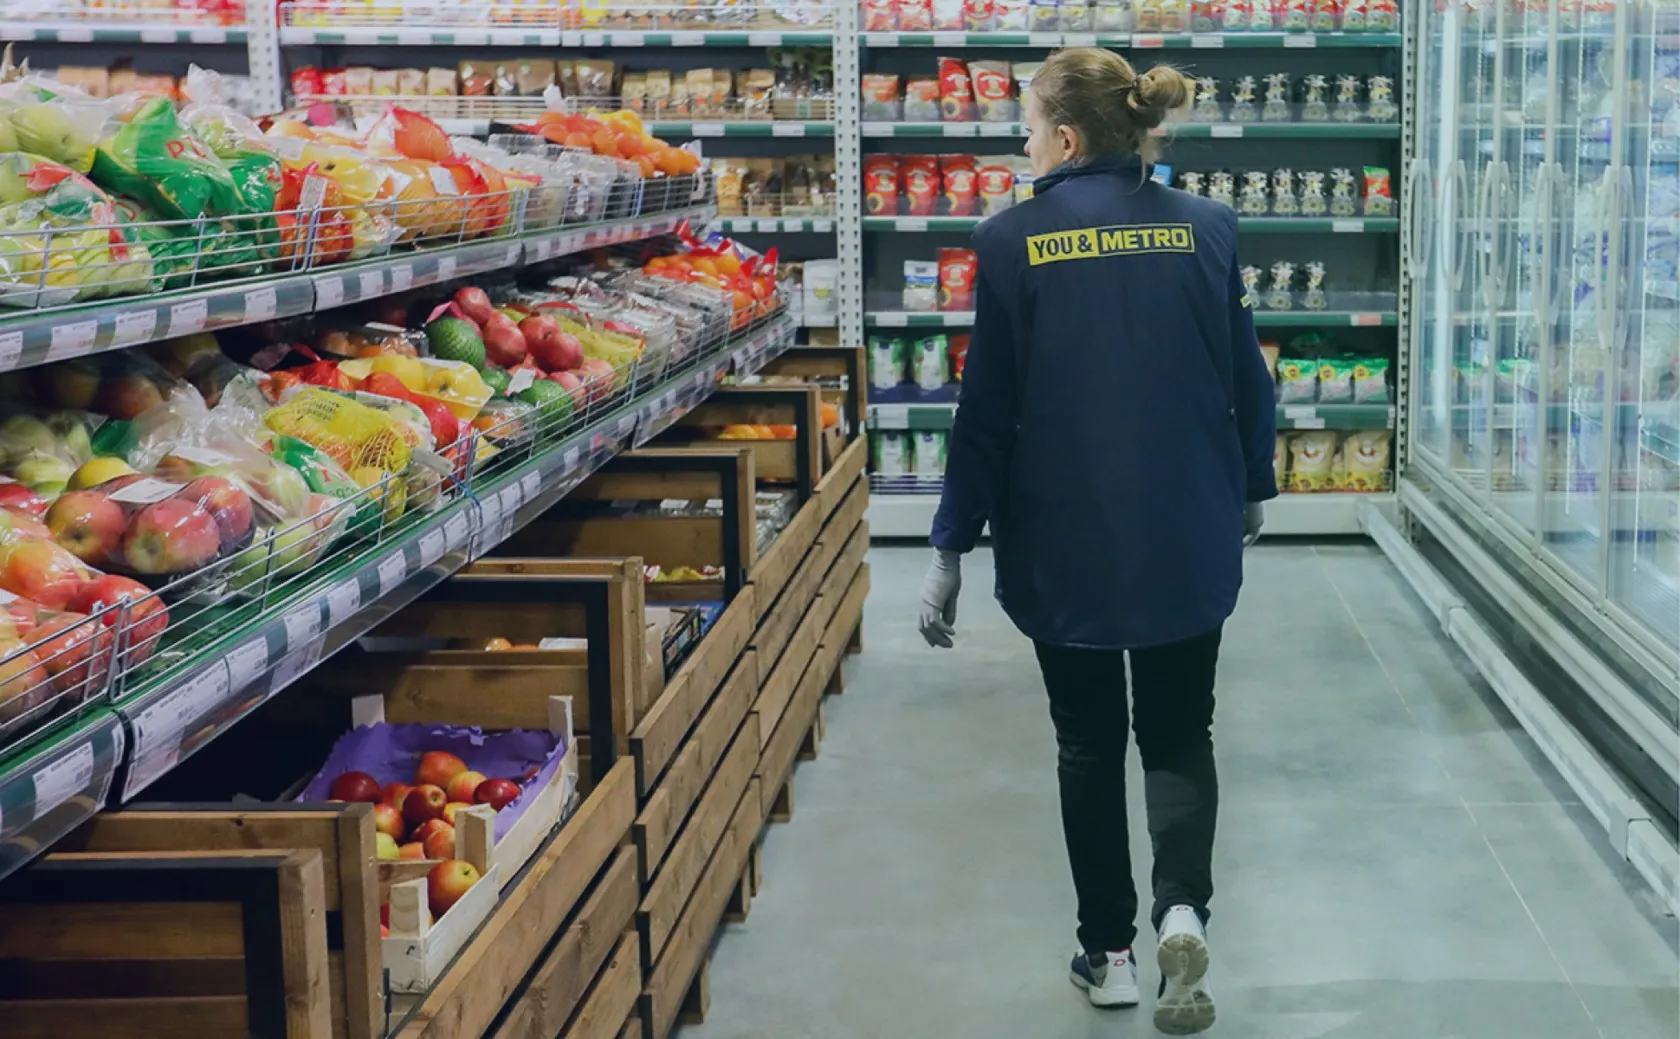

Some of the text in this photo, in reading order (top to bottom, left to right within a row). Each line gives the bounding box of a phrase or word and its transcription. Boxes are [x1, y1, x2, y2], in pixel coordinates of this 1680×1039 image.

[1033, 229, 1189, 259] YOU & METRO
